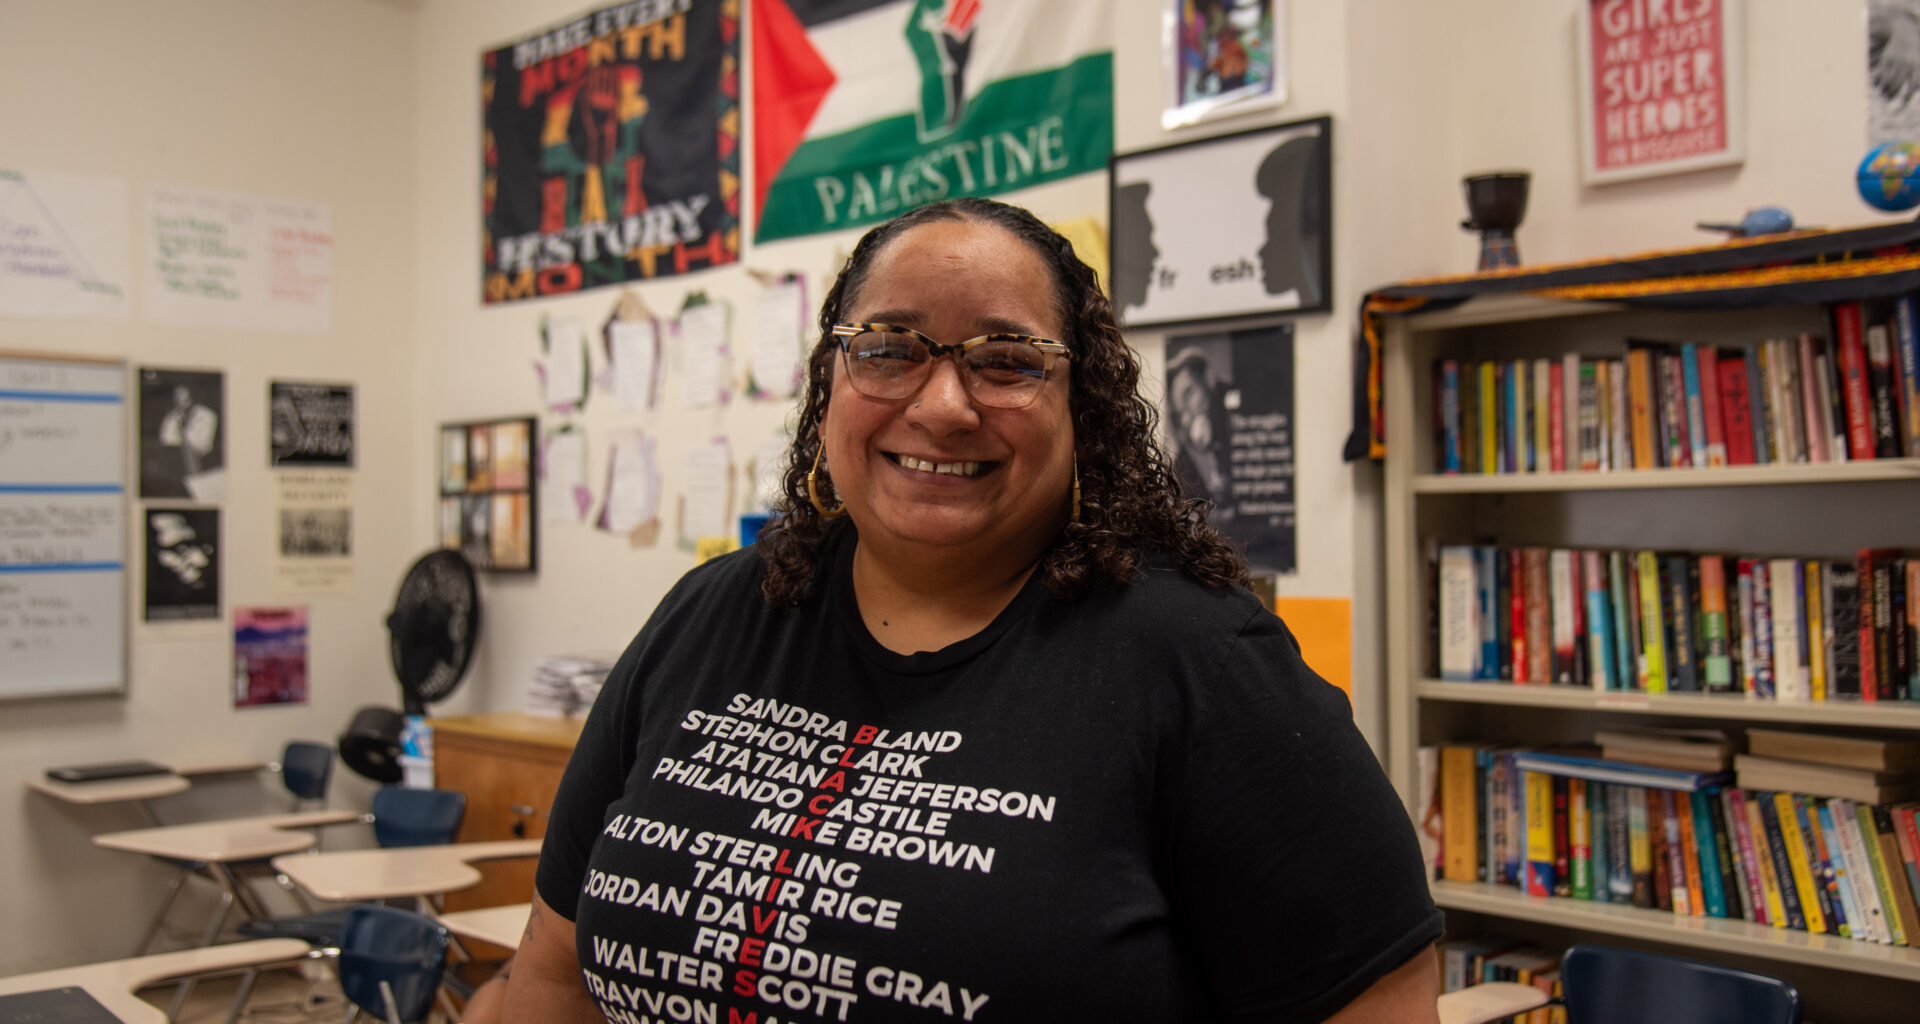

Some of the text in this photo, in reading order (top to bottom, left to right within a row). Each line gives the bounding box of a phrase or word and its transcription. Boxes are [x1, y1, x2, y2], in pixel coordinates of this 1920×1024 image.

[1652, 19, 1711, 55] JUST
[1603, 49, 1716, 107] SUPER
[1605, 93, 1717, 144] HEROES
[815, 116, 1069, 223] PALESTINE
[484, 230, 725, 300] MONTH
[681, 710, 930, 778] STEPHON CLARK
[727, 694, 962, 754] SANDRA BLAND
[652, 758, 952, 836] PHILANDO CASTILE
[691, 741, 1056, 822] ATATIANA JEFFERSON
[604, 814, 861, 888] ALTON STERLING
[751, 808, 995, 873] MIKE BROWN
[584, 869, 810, 943] JORDAN DAVIS
[693, 861, 902, 929] TAMIR RICE
[584, 968, 716, 1024] TRAYVON
[594, 936, 857, 1021] WALTER SCOTT
[693, 927, 989, 1020] FREDDIE GRAY
